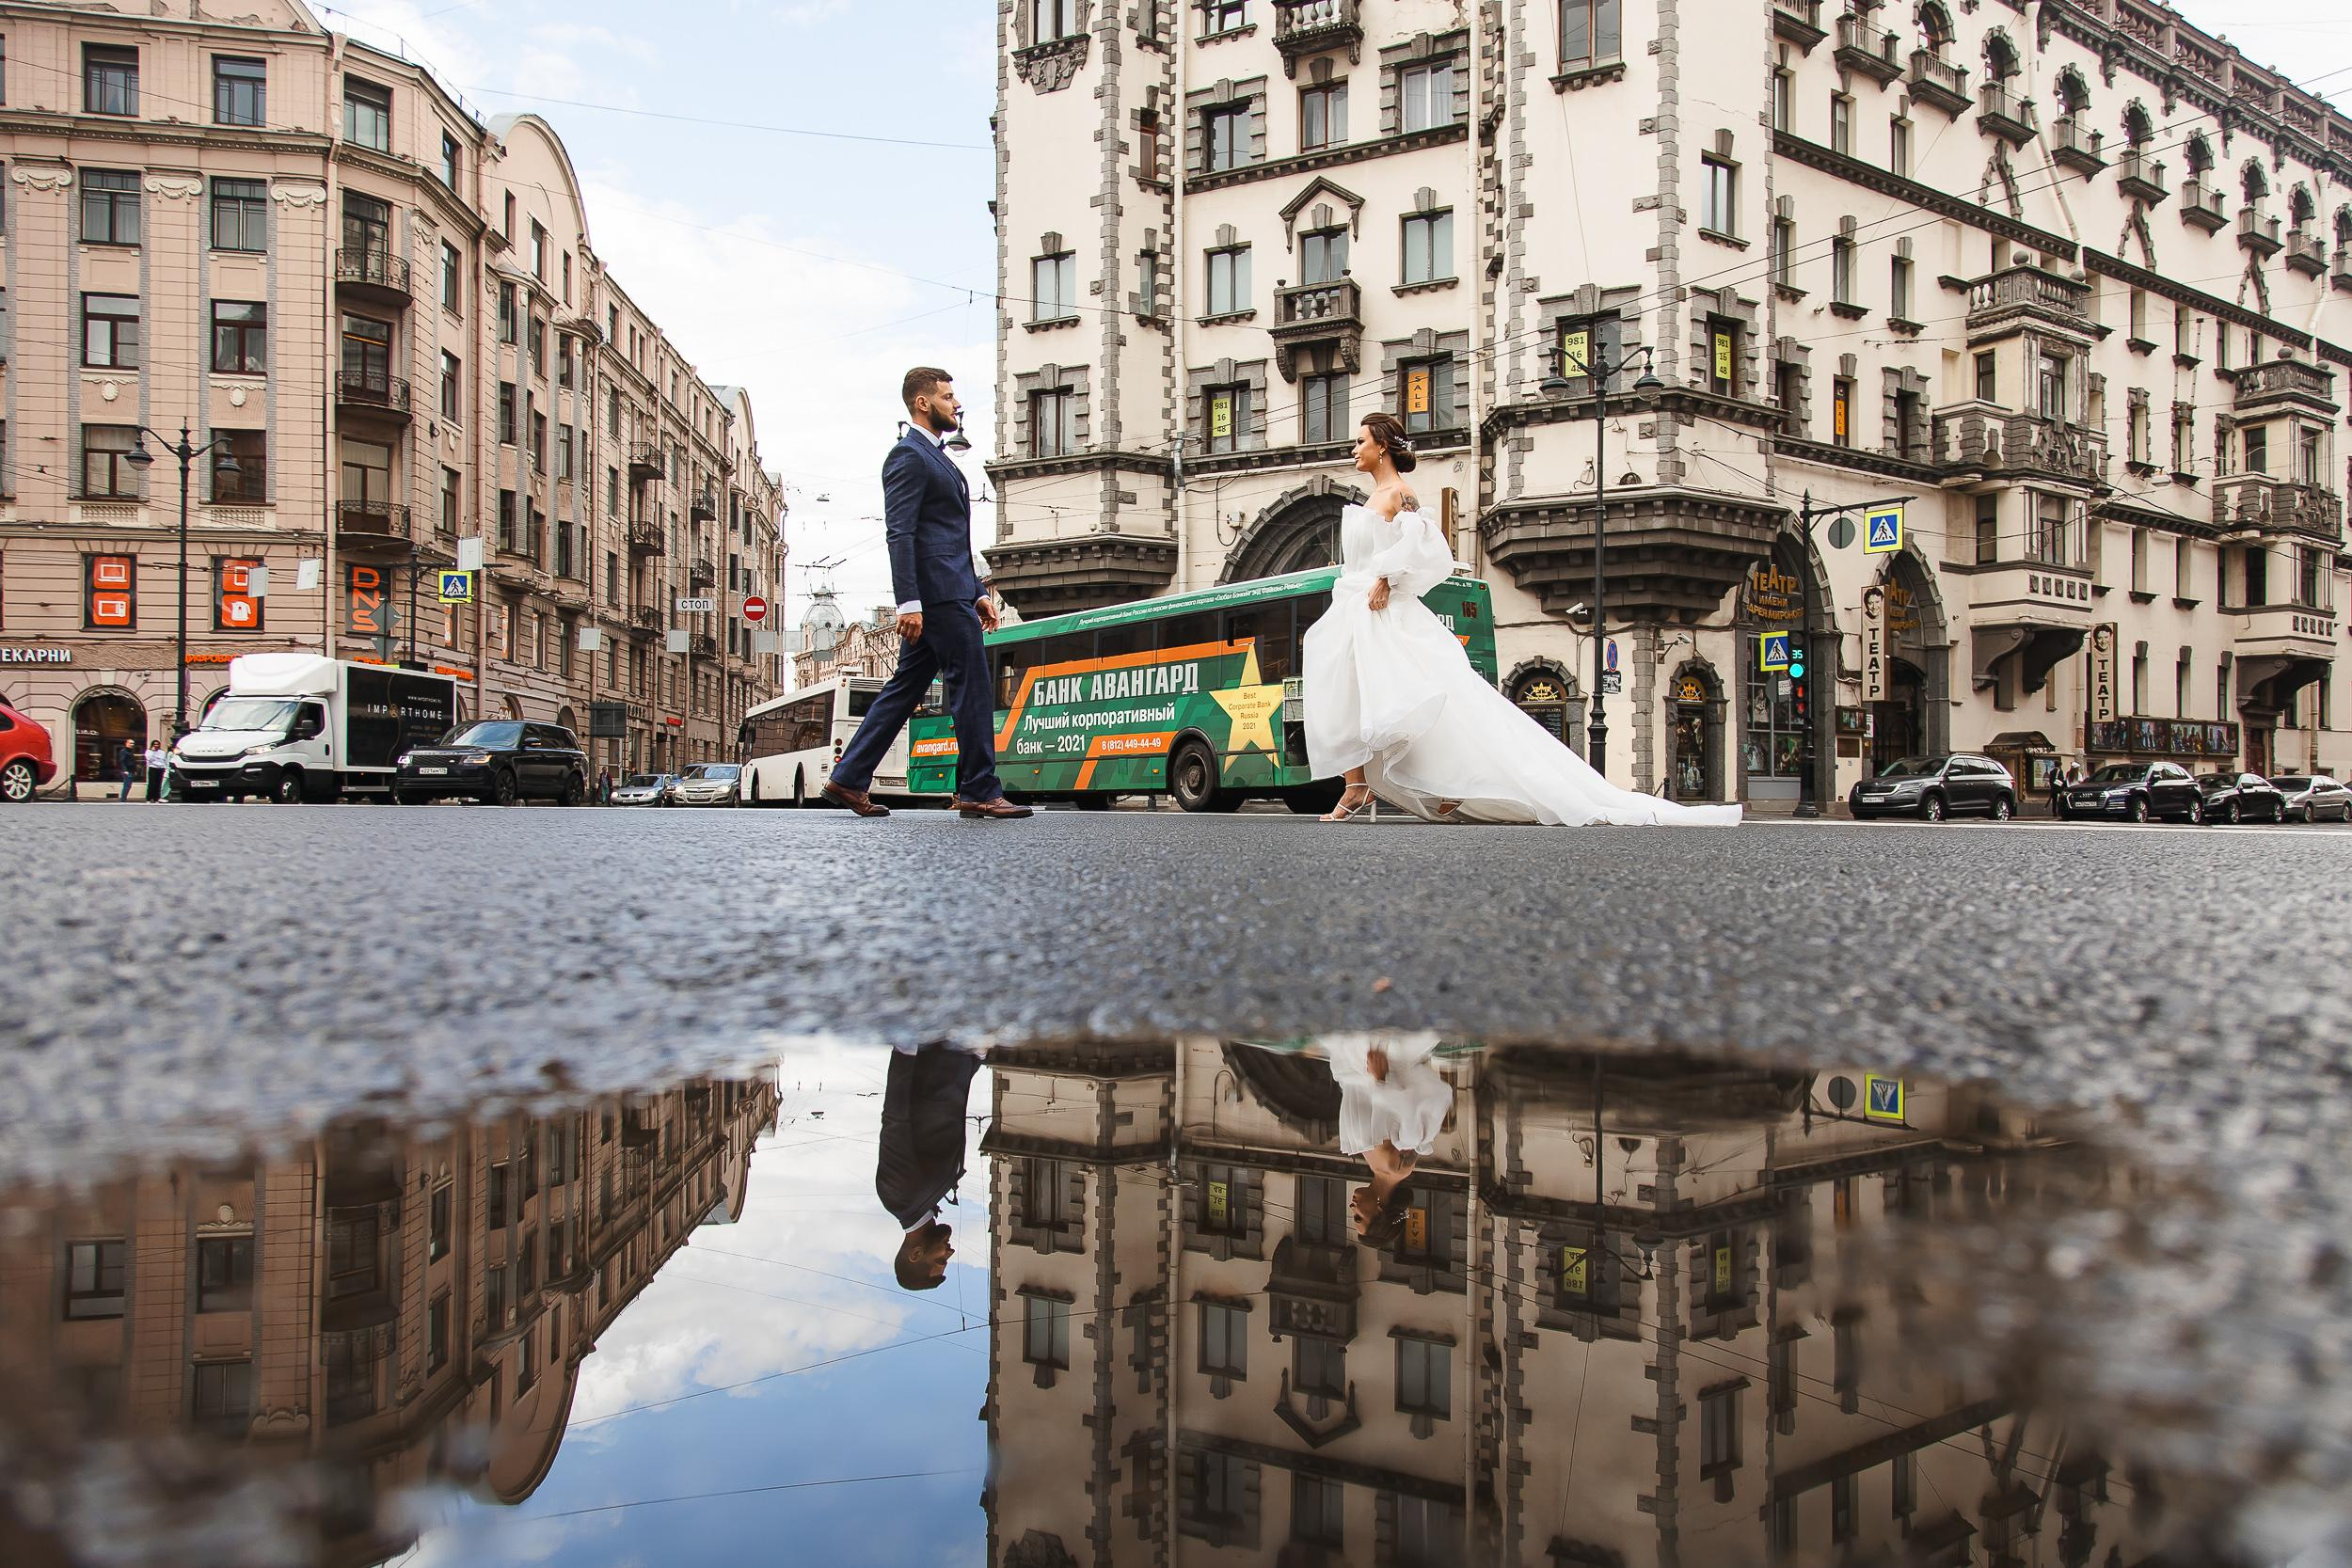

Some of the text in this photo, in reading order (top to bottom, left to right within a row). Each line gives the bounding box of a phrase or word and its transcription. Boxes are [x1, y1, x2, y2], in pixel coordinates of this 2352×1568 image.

[1567, 336, 1584, 346] 981
[1717, 338, 1728, 348] 981
[1719, 352, 1727, 361] 16
[1719, 366, 1727, 374] 48
[1753, 564, 1797, 594] ТЕАТР
[352, 566, 380, 632] DNS
[682, 601, 708, 609] СТОП
[1759, 595, 1788, 607] ИМЕНИ
[1792, 649, 1803, 659] 35
[1868, 628, 1880, 697] ТЕАТР
[1034, 663, 1199, 706] БАНК АВАНГАРД
[2098, 659, 2109, 720] ТЕАТР
[1024, 702, 1175, 734] Лучший корпоративный
[916, 740, 958, 754] avangard.ru
[1016, 737, 1043, 754] банк
[1057, 734, 1085, 753] 2021
[1102, 737, 1161, 751] 8 (812) 449-44-49
